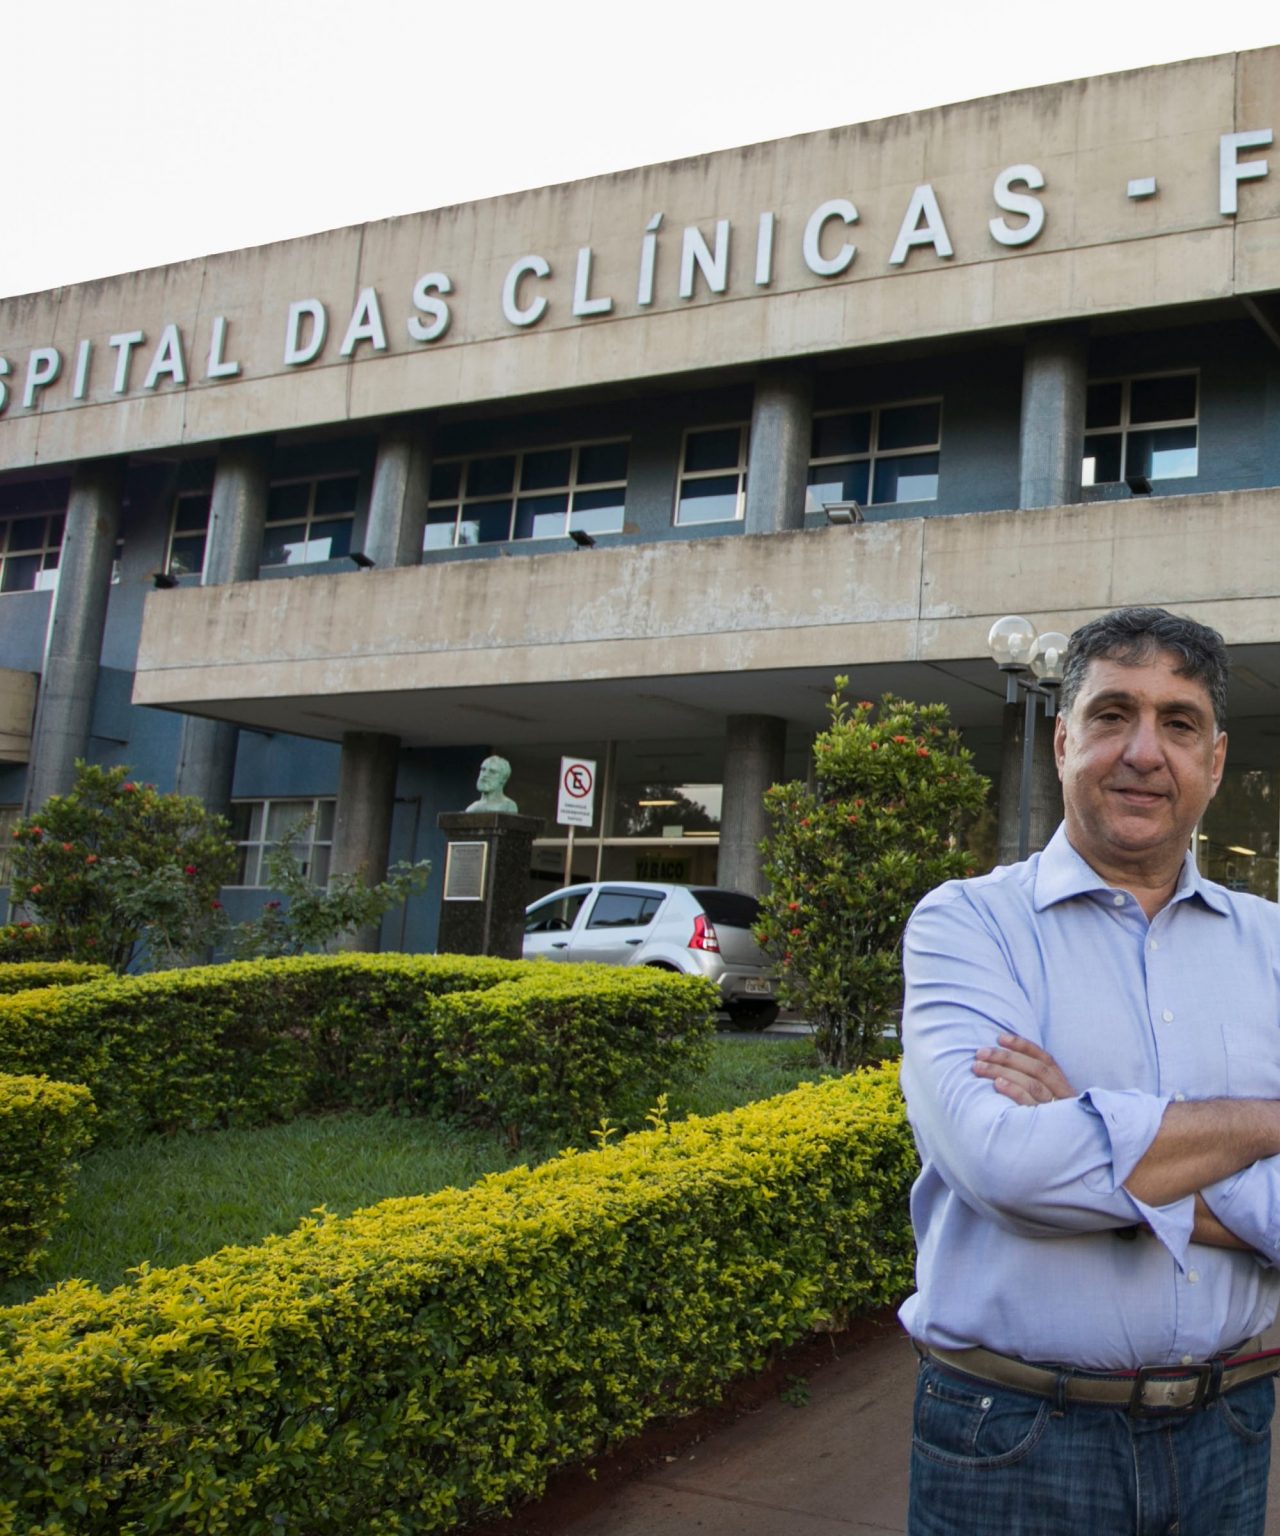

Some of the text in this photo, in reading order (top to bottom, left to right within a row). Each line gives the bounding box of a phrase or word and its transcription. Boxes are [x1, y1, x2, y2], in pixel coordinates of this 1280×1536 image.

[0, 315, 241, 412] PITAL
[283, 273, 454, 366] DAS
[502, 164, 1047, 328] CLÍNICAS
[1127, 177, 1157, 201] -
